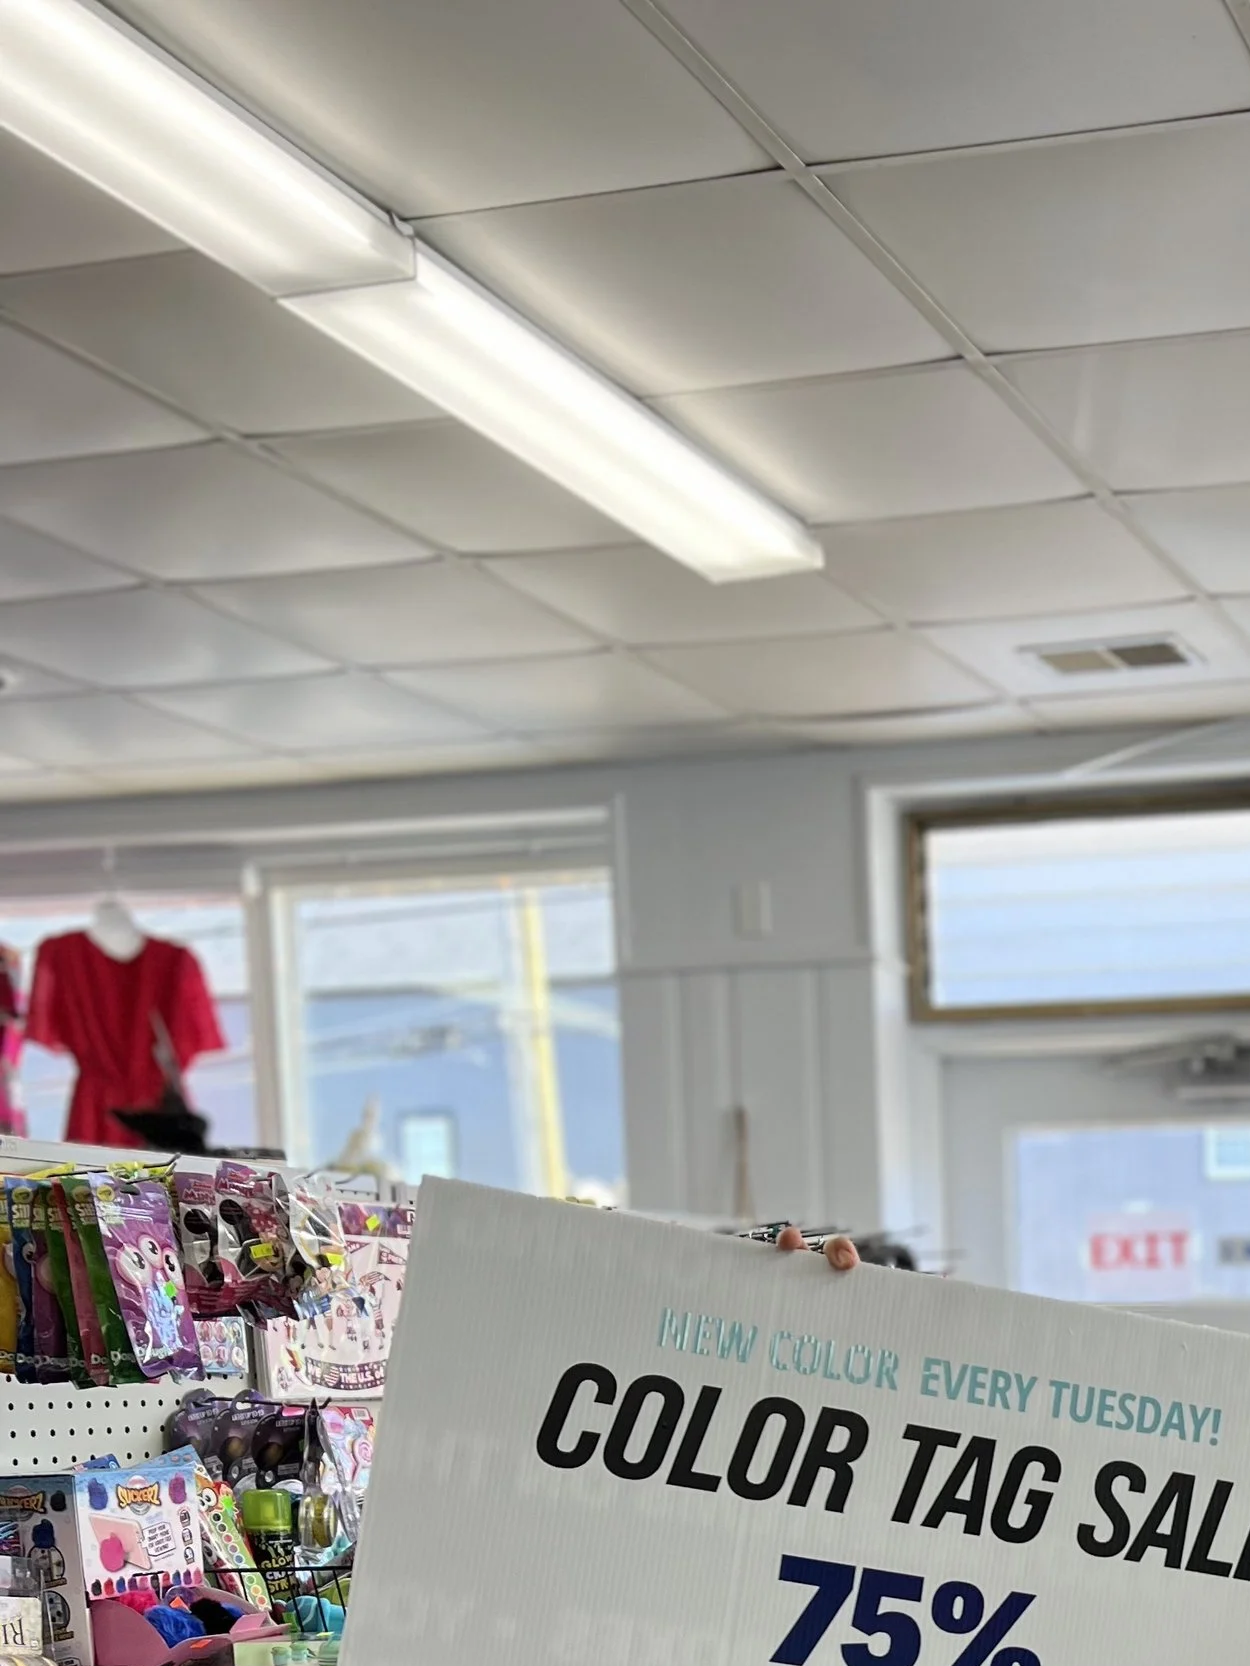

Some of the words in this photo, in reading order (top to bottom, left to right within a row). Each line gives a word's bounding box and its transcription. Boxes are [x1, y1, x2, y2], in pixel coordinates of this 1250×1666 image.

[1088, 1229, 1188, 1272] EXIT
[657, 1305, 759, 1365] NEW
[767, 1328, 901, 1393] COLOR
[920, 1357, 1038, 1412] EVERY
[1048, 1379, 1223, 1447] TUESDAY!
[117, 1482, 161, 1509] SUCKERZ
[535, 1361, 871, 1514] COLOR
[890, 1422, 1063, 1545] TAG
